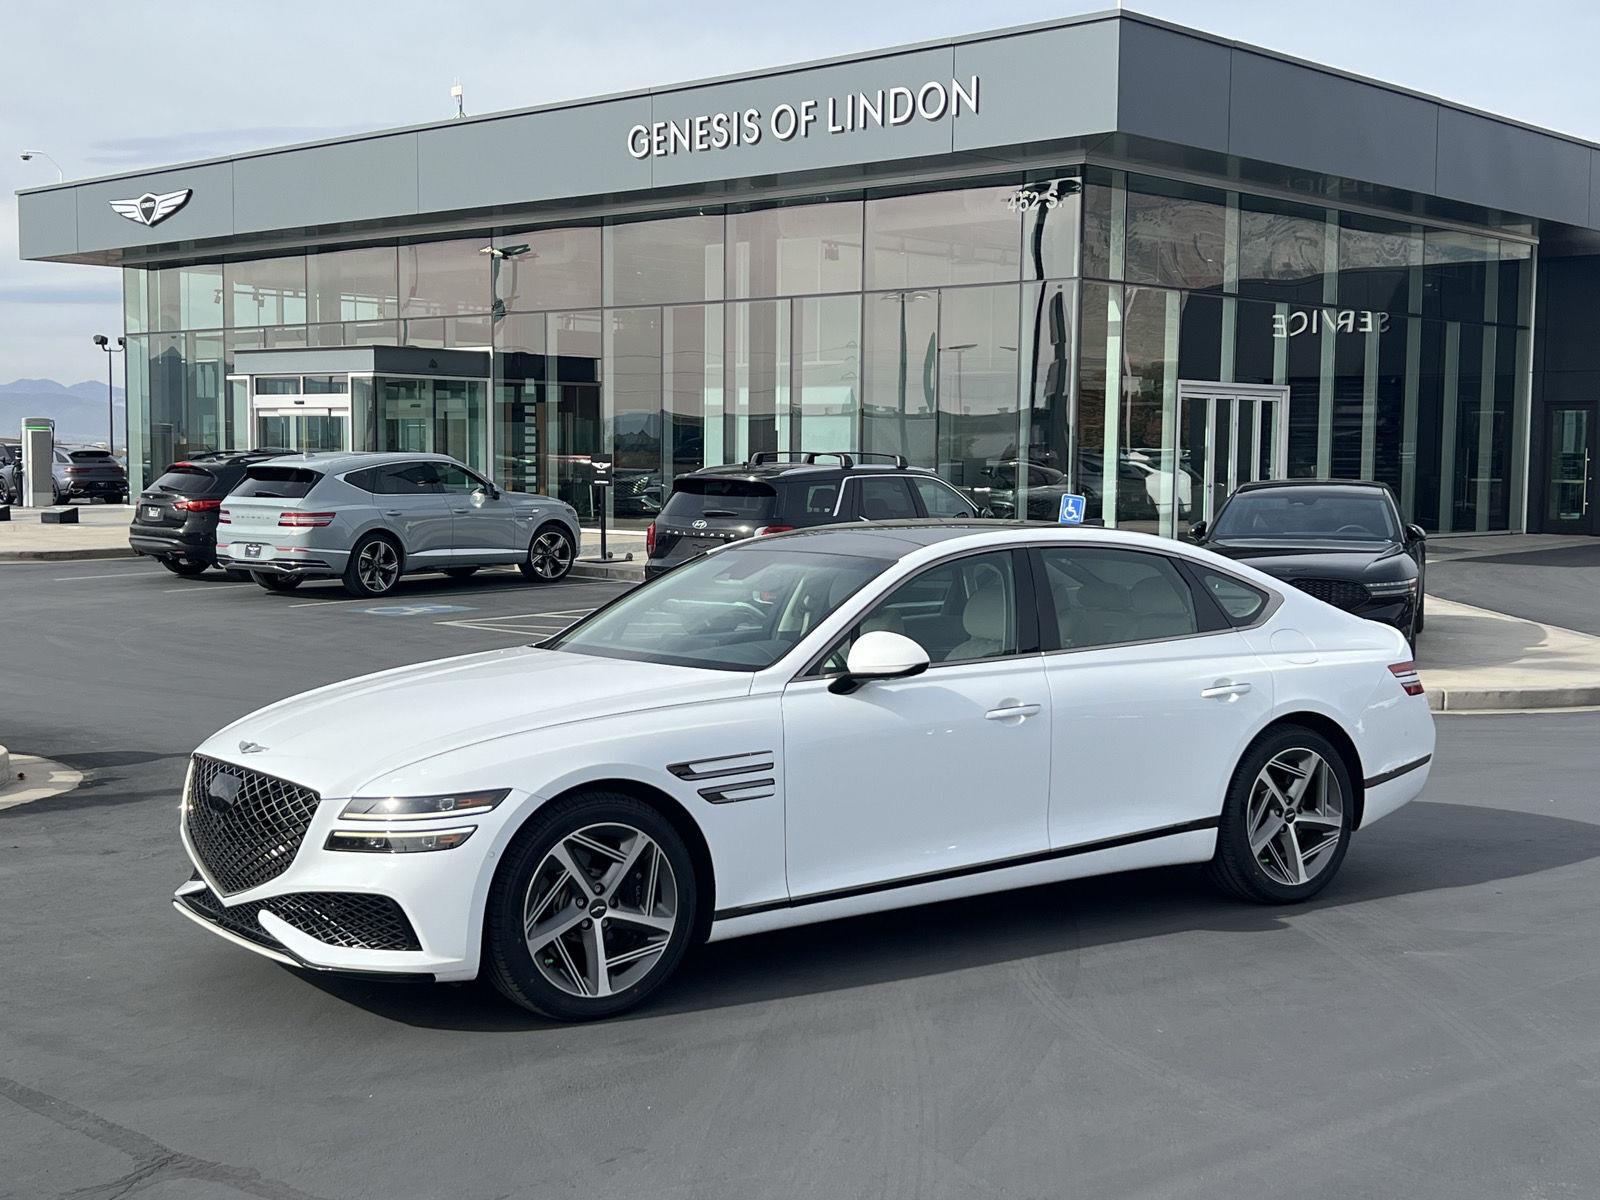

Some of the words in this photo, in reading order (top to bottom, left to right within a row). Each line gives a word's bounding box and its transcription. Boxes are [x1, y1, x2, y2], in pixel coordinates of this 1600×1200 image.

[628, 108, 761, 159] GENESIS
[770, 101, 817, 140] OF
[828, 75, 979, 133] LINDON
